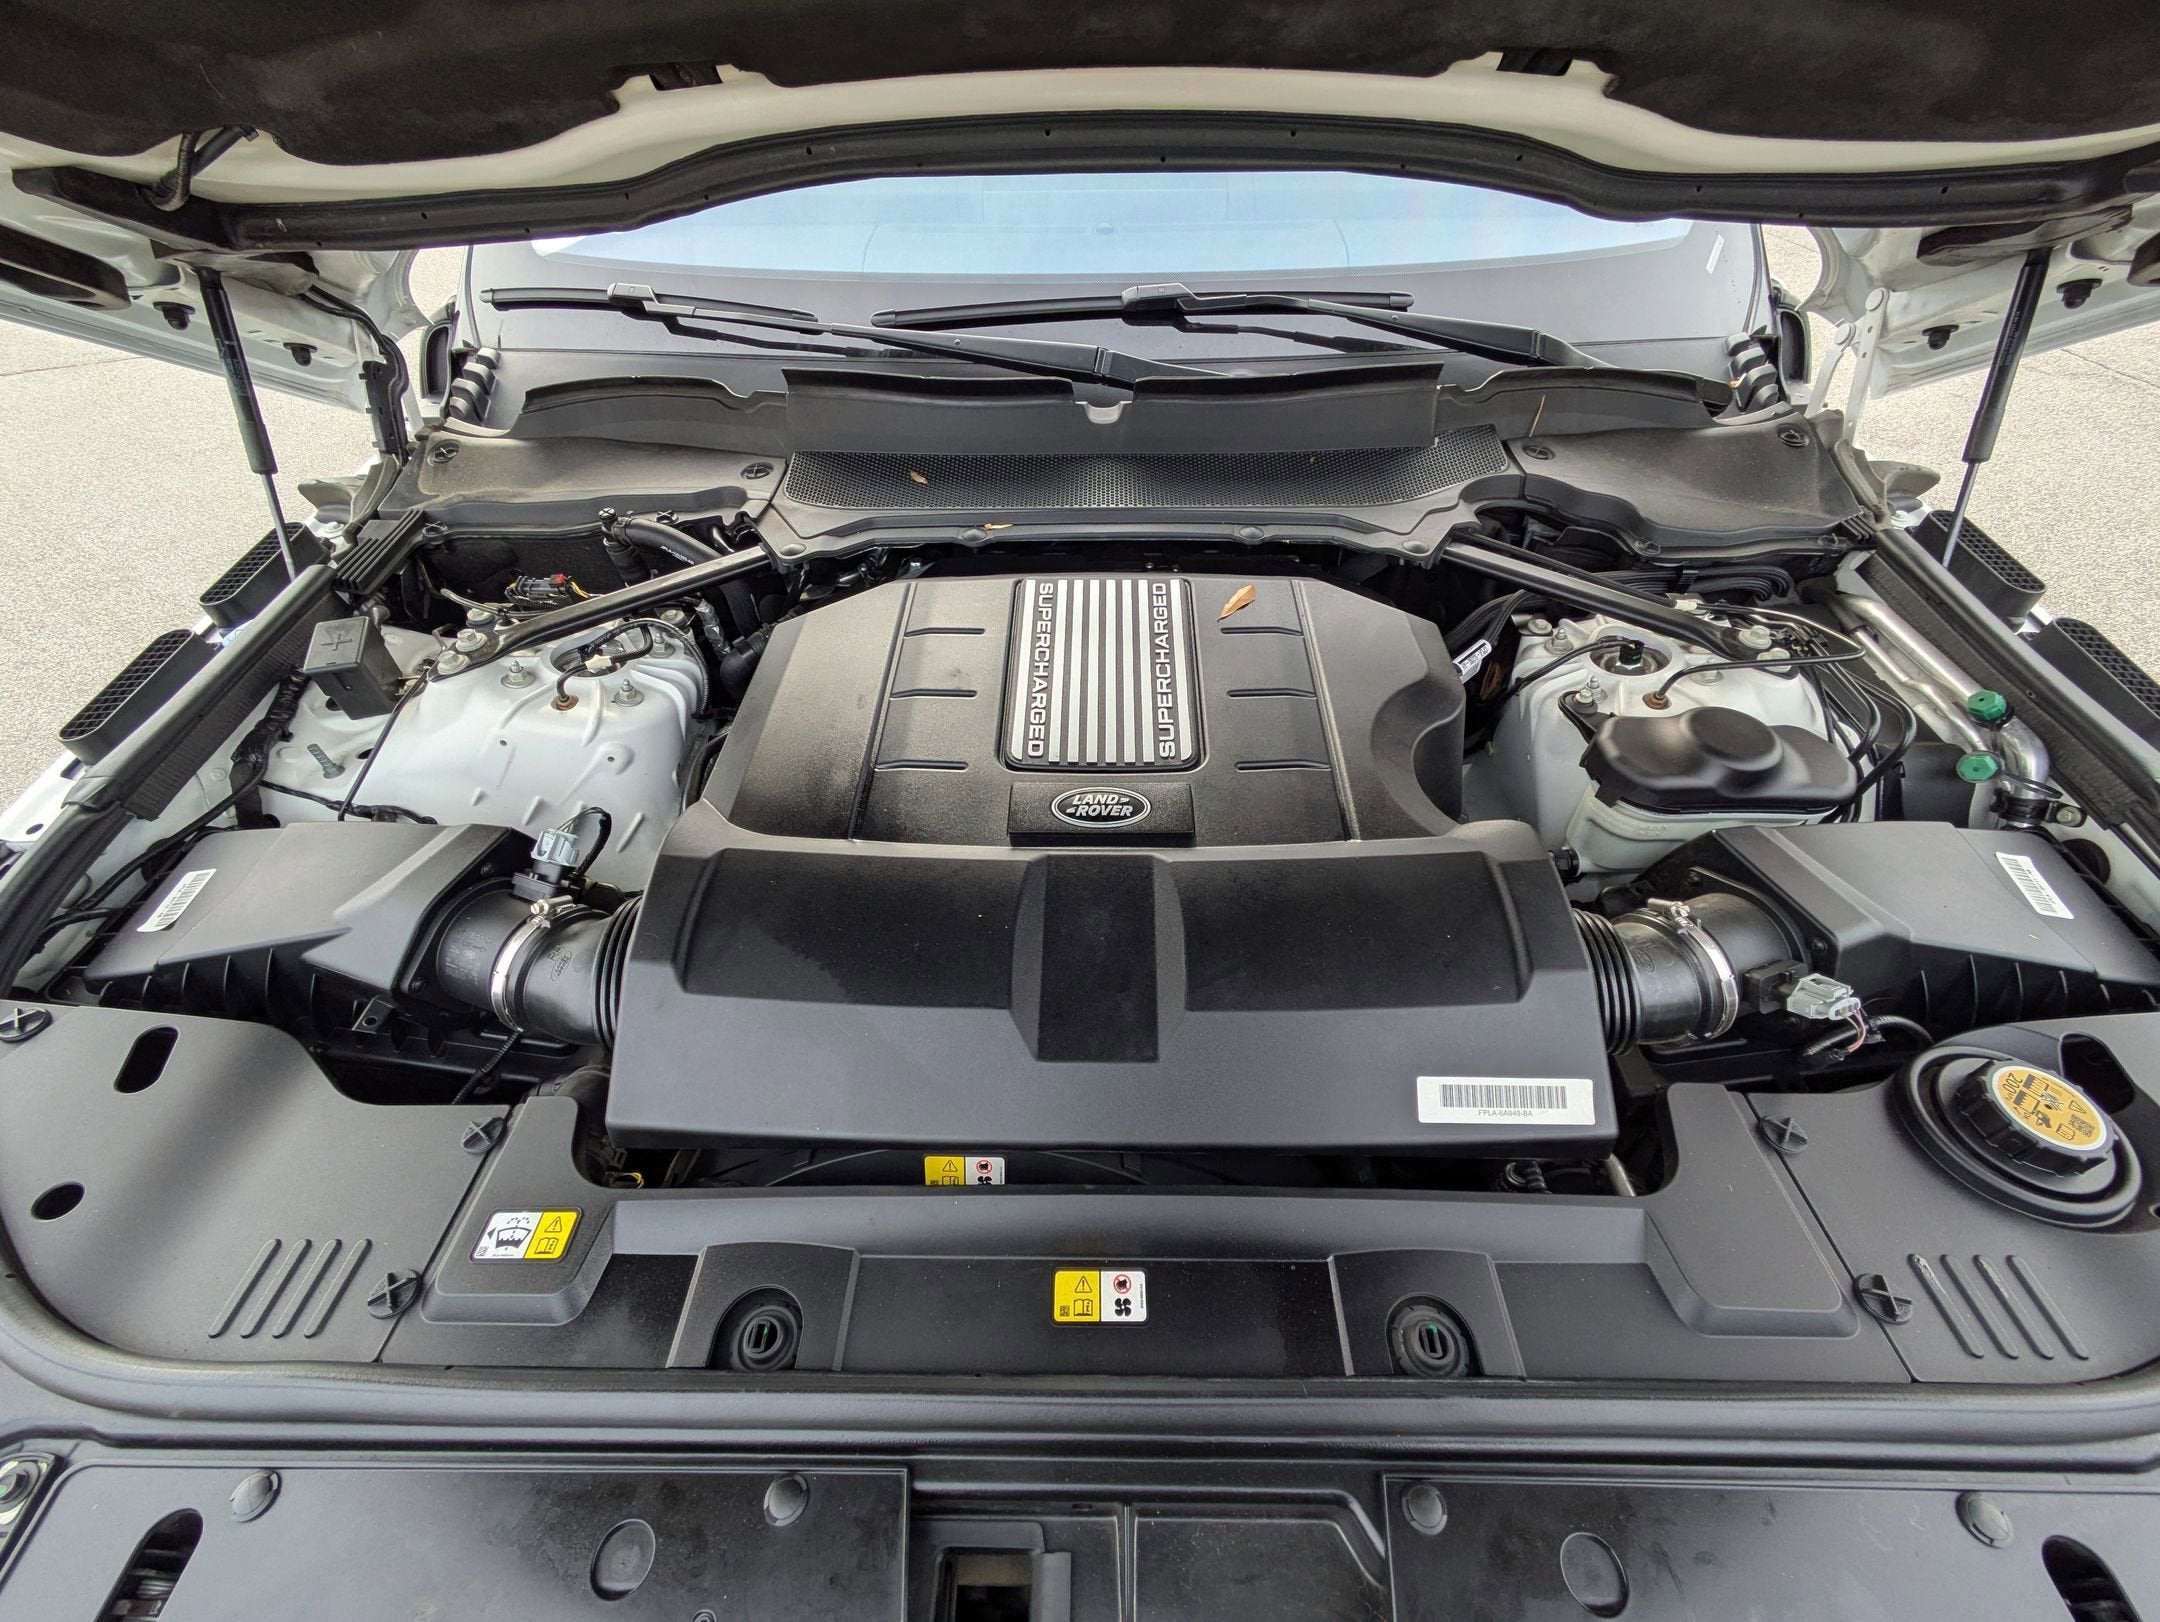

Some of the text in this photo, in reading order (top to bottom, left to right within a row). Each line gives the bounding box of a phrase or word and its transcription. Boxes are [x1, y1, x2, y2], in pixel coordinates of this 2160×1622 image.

[1028, 582, 1053, 758] SUPERCHARGED
[1152, 582, 1176, 758] SUPERCHARGED
[1072, 794, 1119, 804] LAND
[1075, 804, 1133, 816] ROVER
[2003, 1072, 2023, 1093] 200
